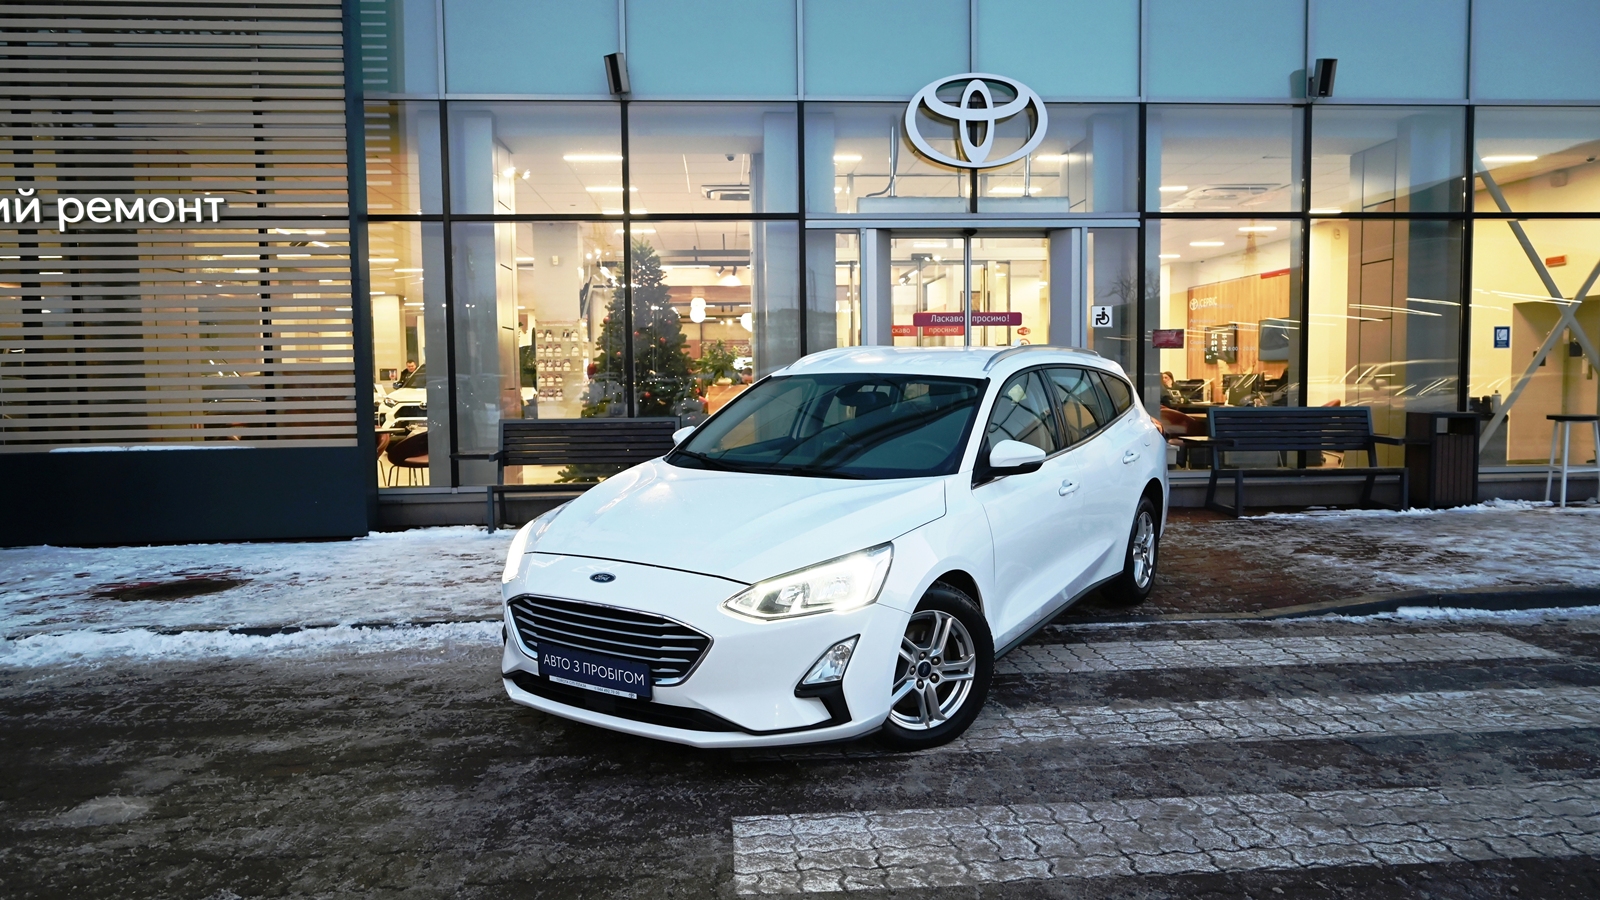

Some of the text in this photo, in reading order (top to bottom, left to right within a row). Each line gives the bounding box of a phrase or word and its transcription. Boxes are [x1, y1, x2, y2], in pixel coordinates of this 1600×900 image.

[57, 197, 225, 232] ремонт
[931, 314, 1010, 324] Ласкаво просимо!
[928, 326, 959, 334] просимо!
[543, 653, 571, 670] АВТО
[582, 662, 645, 686] ПРОБІГОМ
